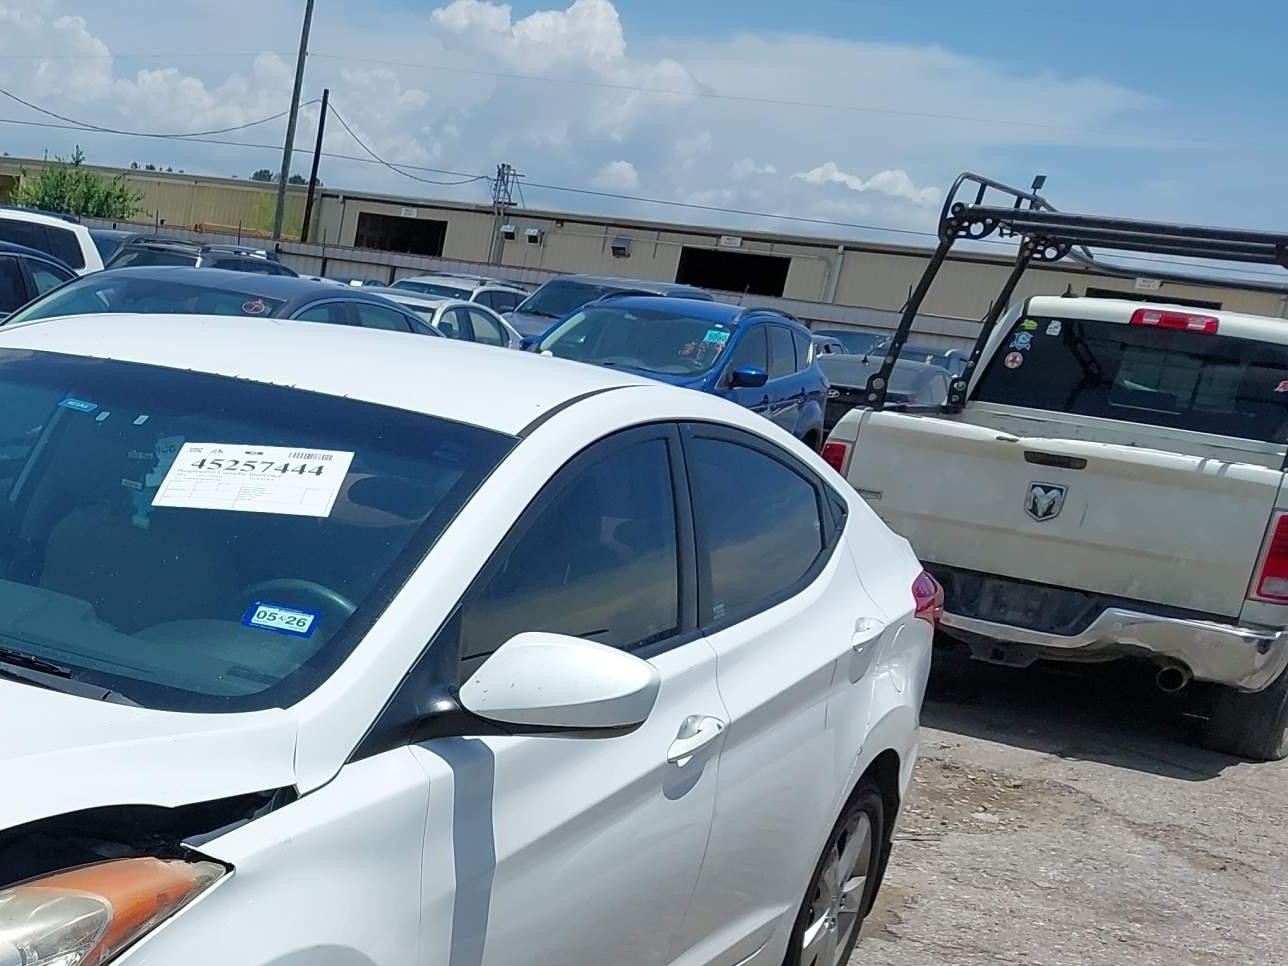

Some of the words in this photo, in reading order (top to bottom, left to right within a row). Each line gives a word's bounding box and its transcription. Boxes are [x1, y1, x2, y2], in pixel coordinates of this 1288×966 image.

[191, 458, 324, 477] 45257444
[256, 609, 279, 622] 05
[284, 615, 309, 628] 26
